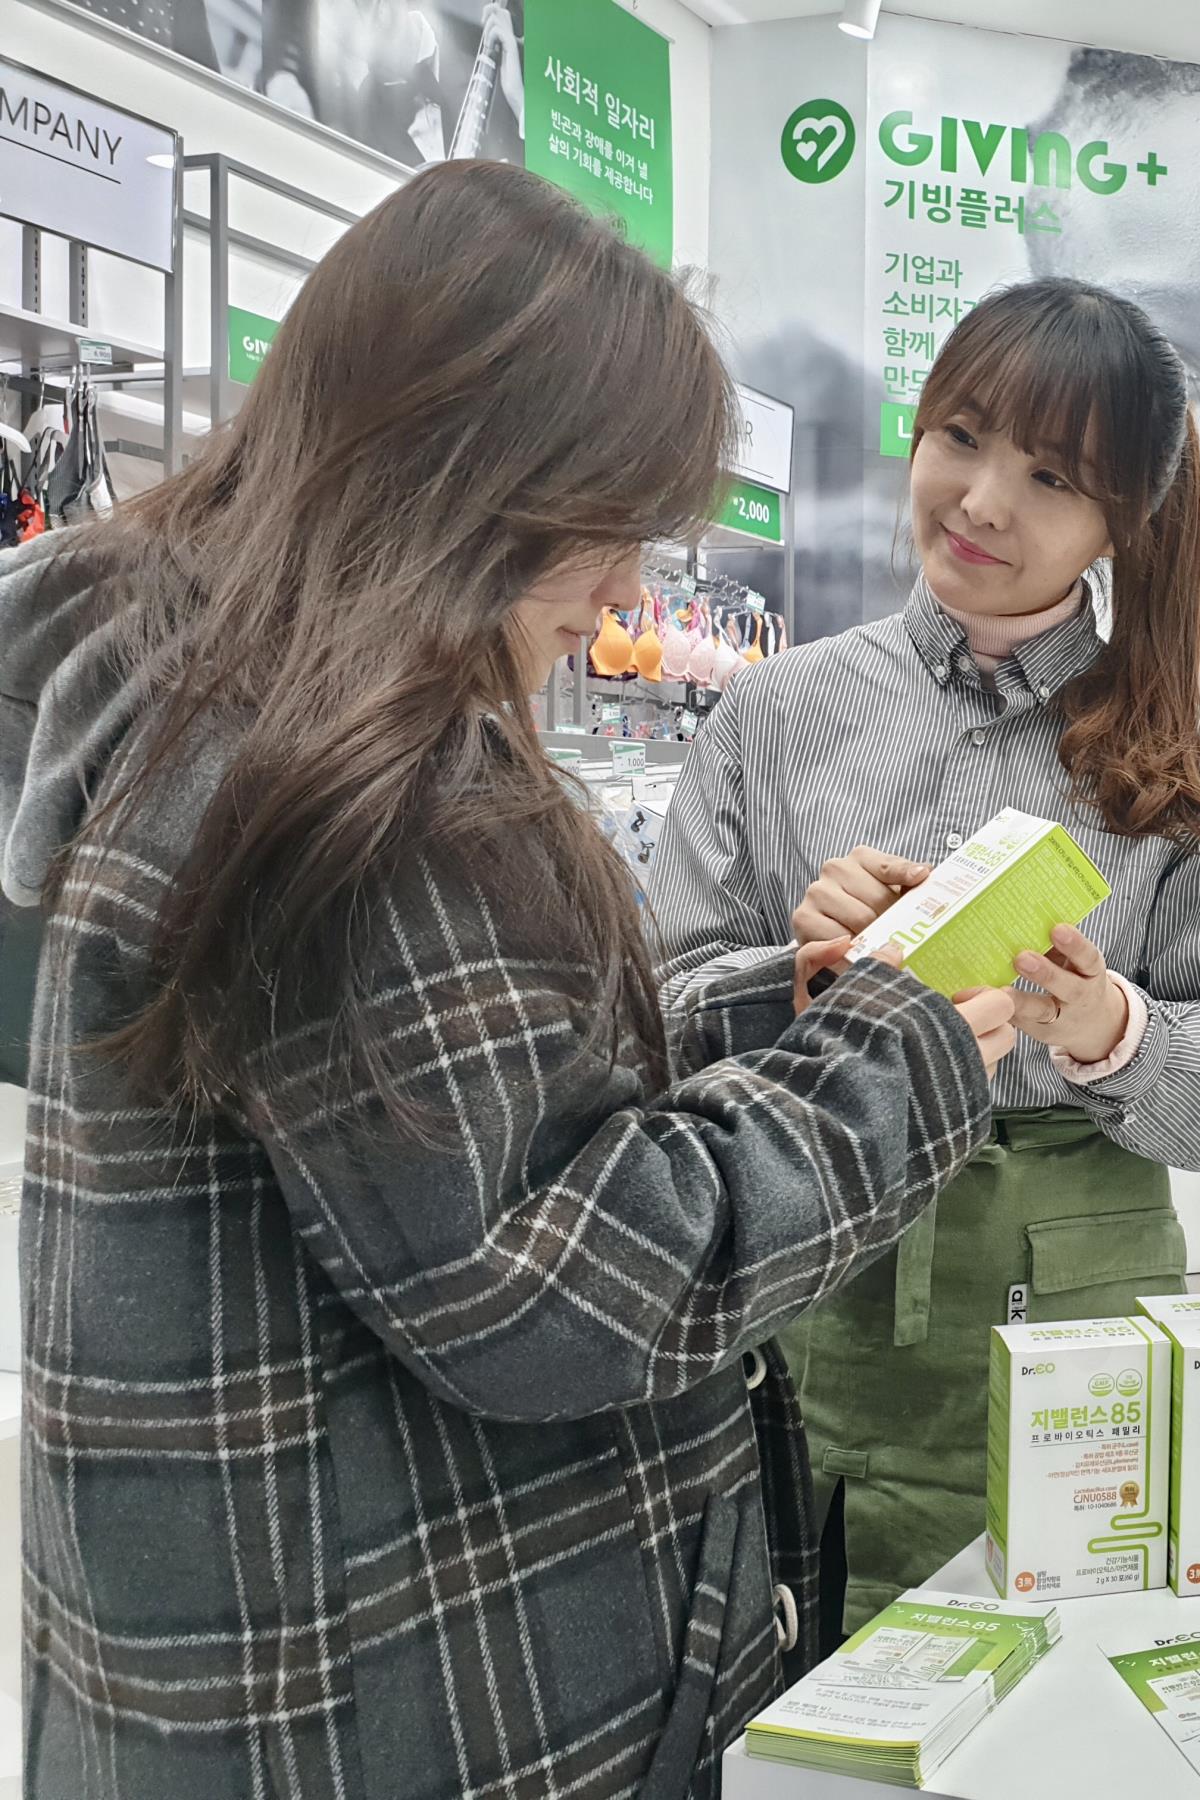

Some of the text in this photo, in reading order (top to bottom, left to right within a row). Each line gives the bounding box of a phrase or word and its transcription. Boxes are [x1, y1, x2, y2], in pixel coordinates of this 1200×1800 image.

[545, 56, 655, 149] 사회적 일자리
[552, 109, 648, 180] 빈곤과 장애를 이겨 낼
[879, 110, 1167, 195] GIVING+
[549, 133, 653, 205] 삶의 기회를 제공합니다
[884, 179, 1062, 235] 기빙플러스
[885, 253, 963, 289] 기업과
[883, 327, 934, 361] 함께
[1030, 1401, 1141, 1431] 지밸런스85
[1031, 1425, 1140, 1442] 프로바이오틱스 패밀리
[1073, 1492, 1117, 1504] CJNU0588
[910, 1613, 1000, 1631] 지밸런스85
